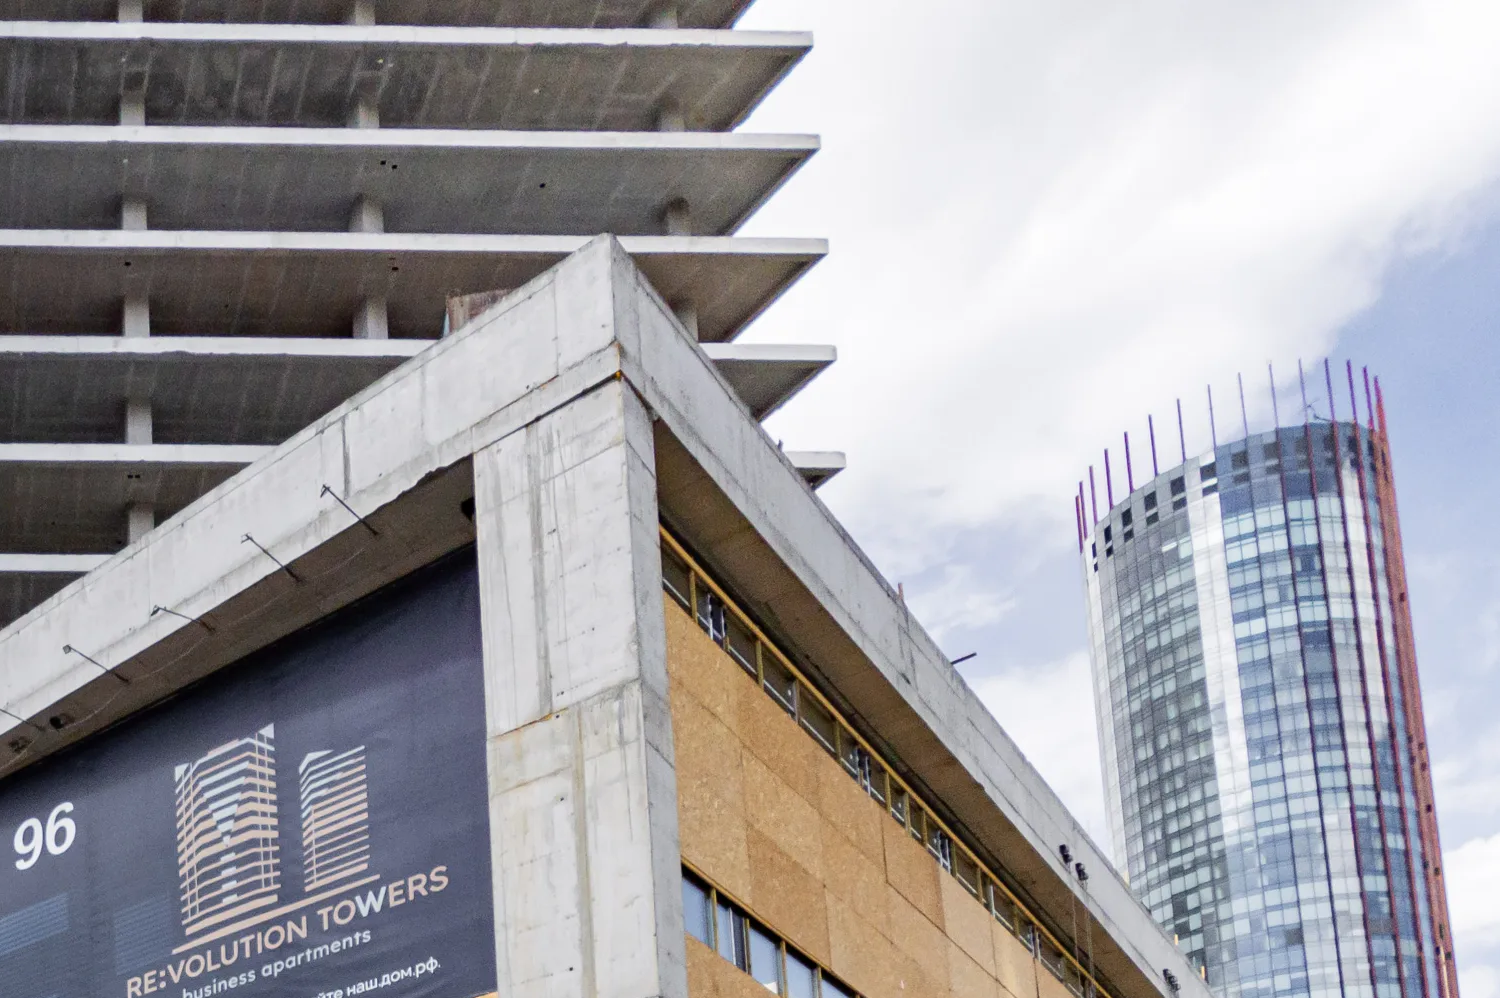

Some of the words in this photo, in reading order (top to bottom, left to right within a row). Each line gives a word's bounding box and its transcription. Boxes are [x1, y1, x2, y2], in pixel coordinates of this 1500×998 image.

[13, 801, 76, 870] 96
[317, 866, 449, 931] TOWERS
[261, 930, 371, 979] apartments
[346, 955, 441, 997] наш.дом.рф.
